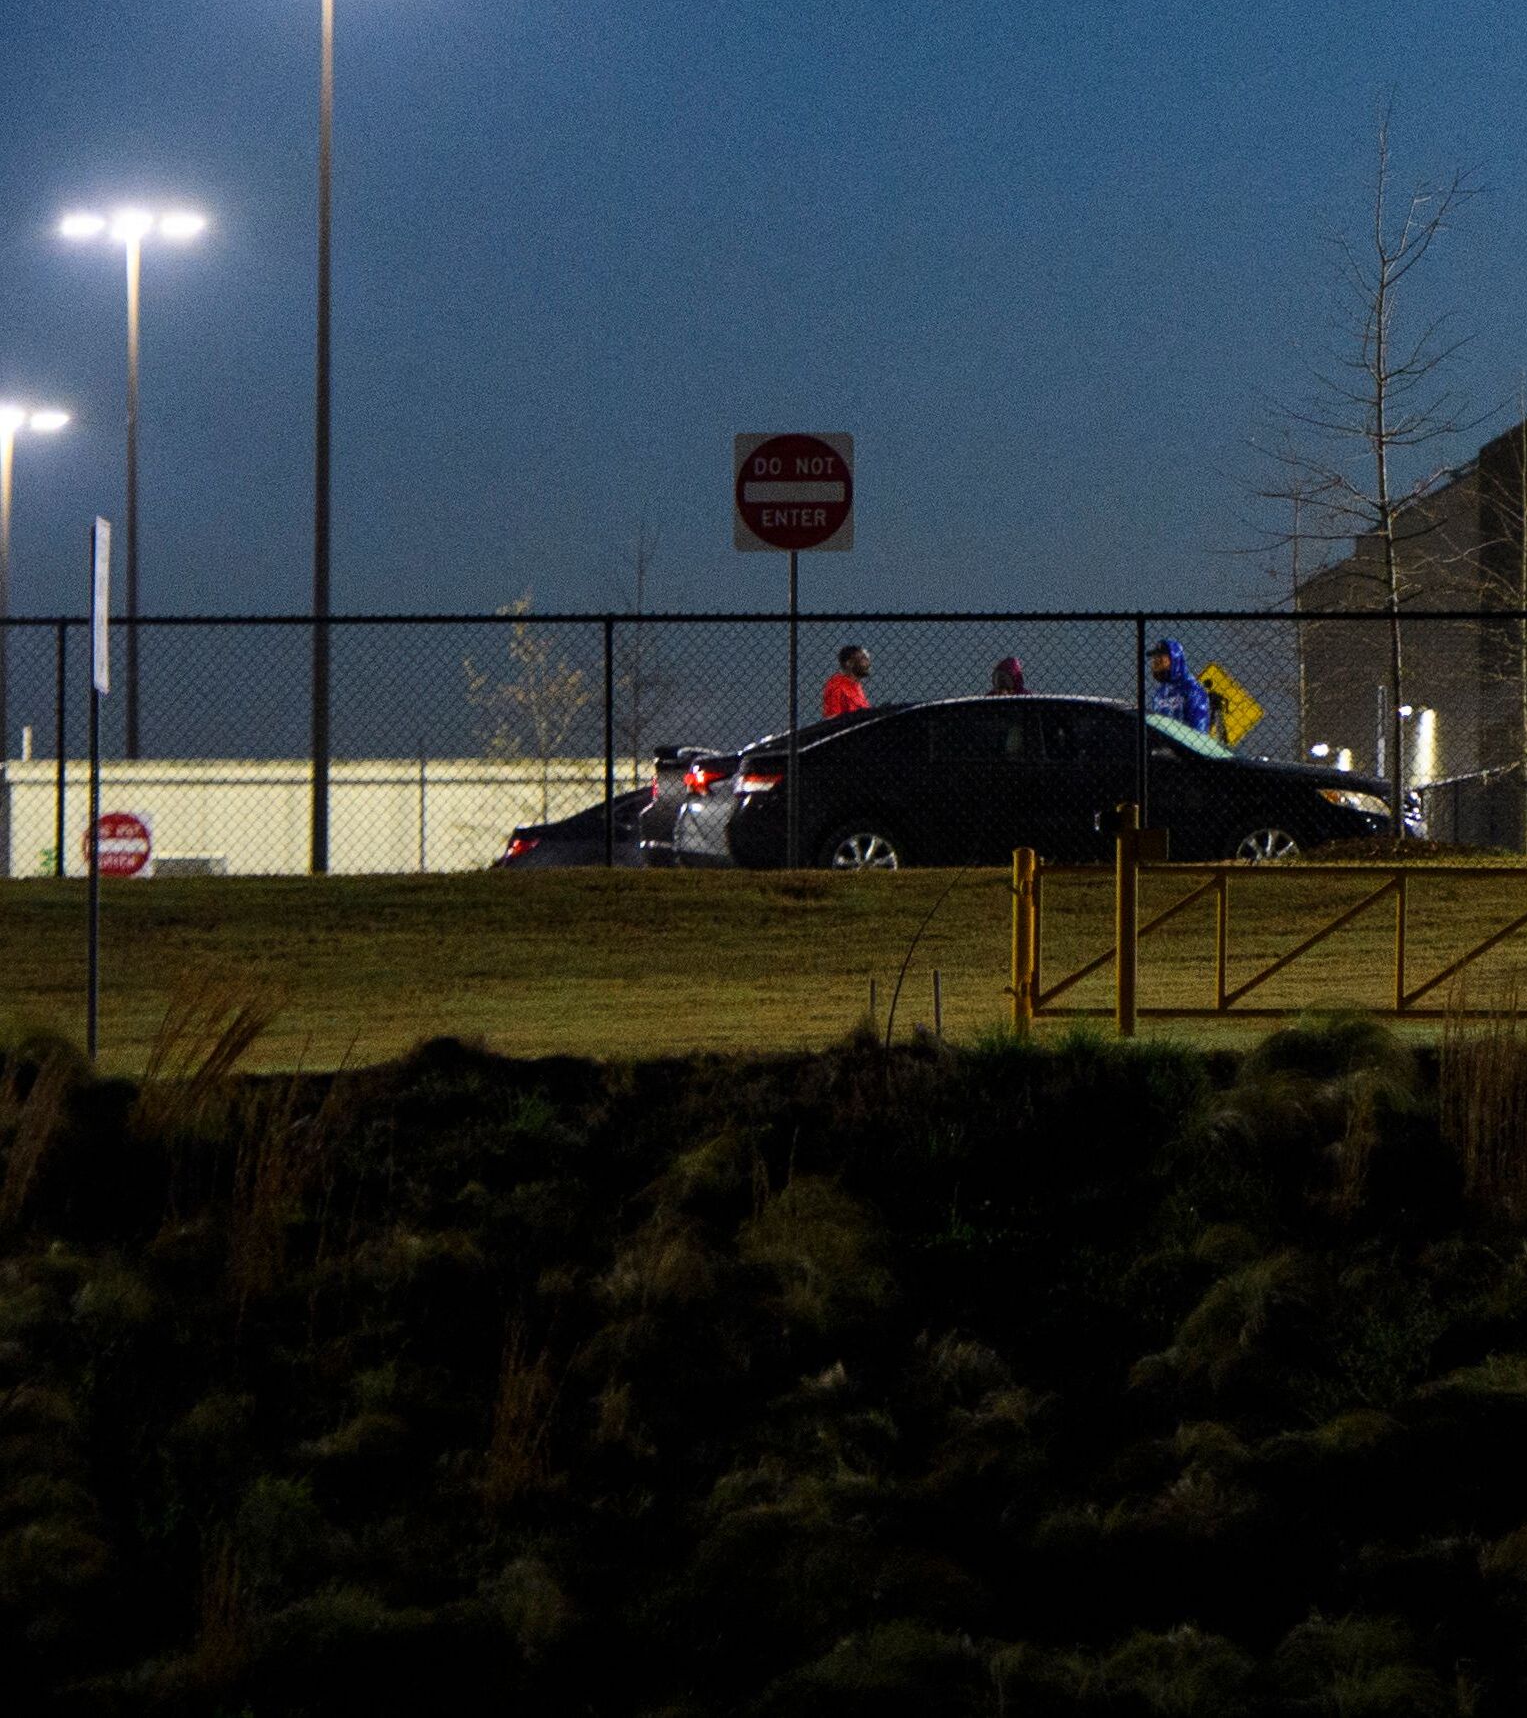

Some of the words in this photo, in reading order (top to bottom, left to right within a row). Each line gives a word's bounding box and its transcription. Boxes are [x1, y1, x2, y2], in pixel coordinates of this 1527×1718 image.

[753, 457, 783, 475] DO
[795, 457, 834, 475] NOT
[761, 508, 827, 528] ENTER
